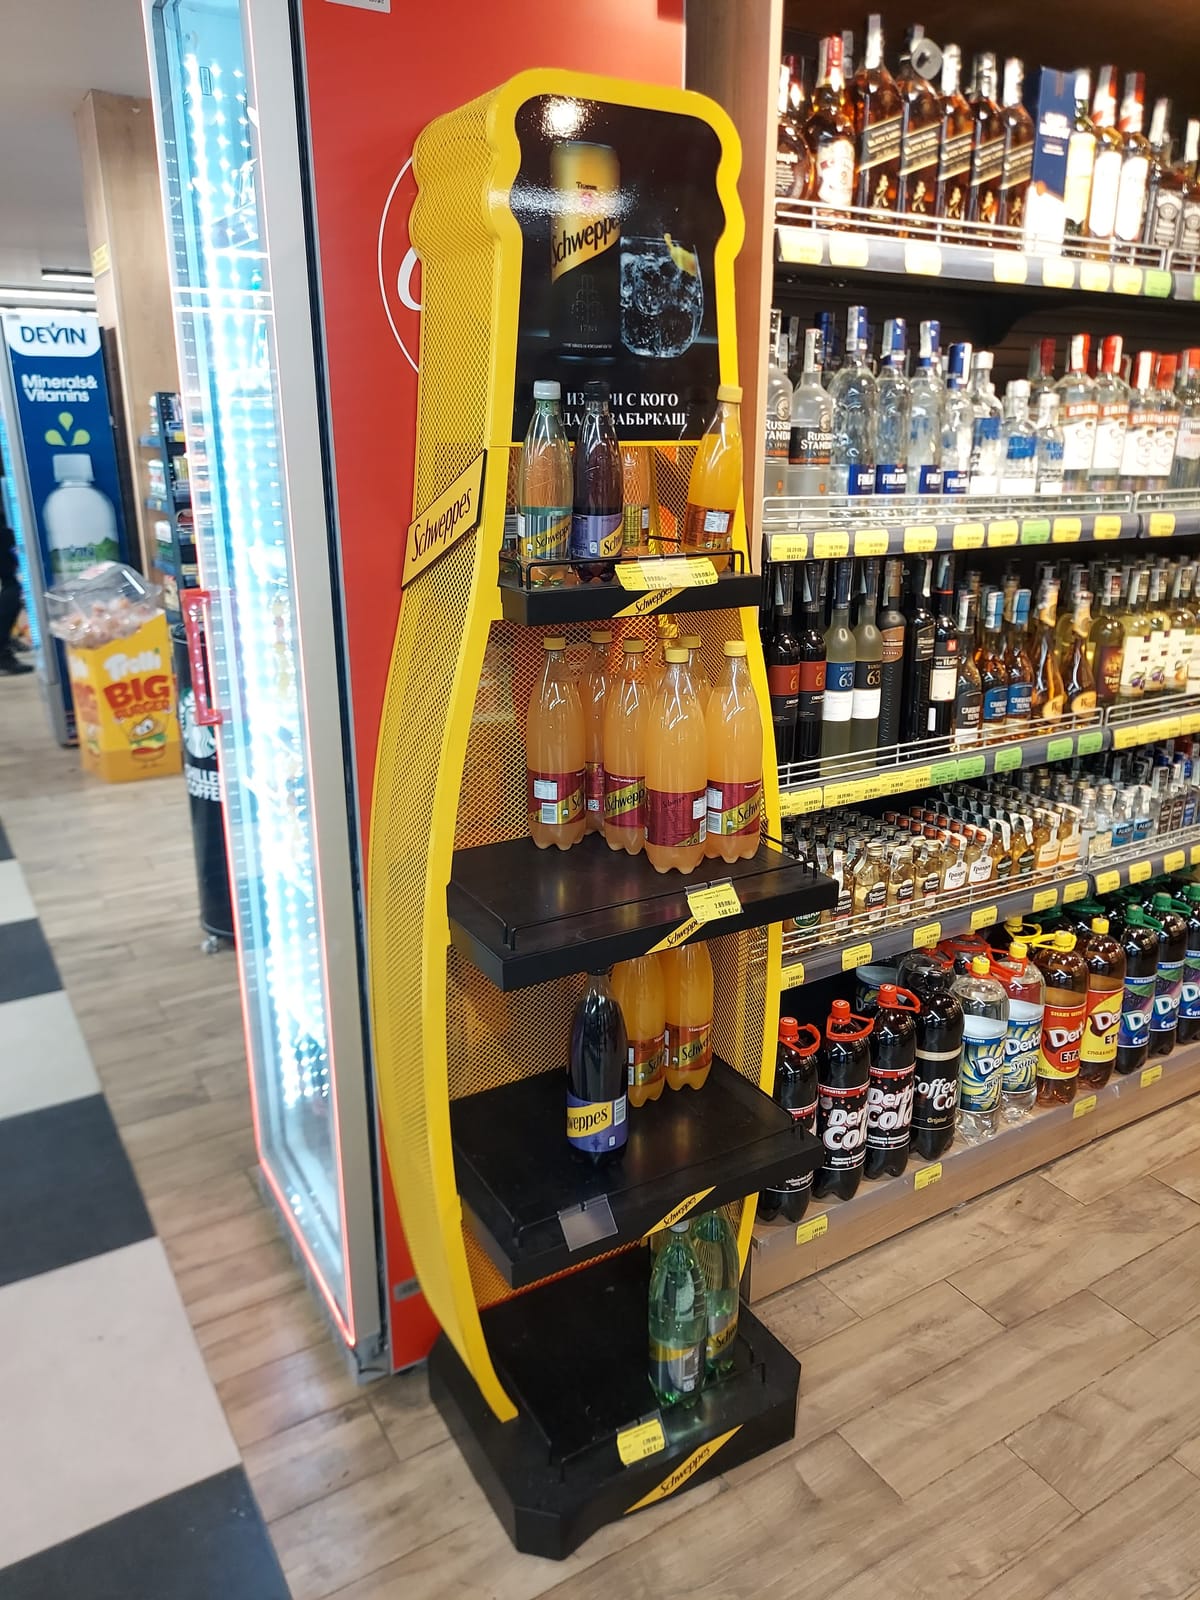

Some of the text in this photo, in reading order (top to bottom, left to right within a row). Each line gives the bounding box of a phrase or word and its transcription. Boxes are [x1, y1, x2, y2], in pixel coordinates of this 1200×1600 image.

[20, 321, 87, 345] DEVIN
[23, 387, 90, 402] Vitamins
[640, 393, 679, 407] КОГО
[411, 487, 472, 562] Schweppes
[839, 671, 854, 688] 63
[866, 670, 881, 686] 63
[104, 675, 170, 710] BIG
[660, 1446, 711, 1494] Schweppes
